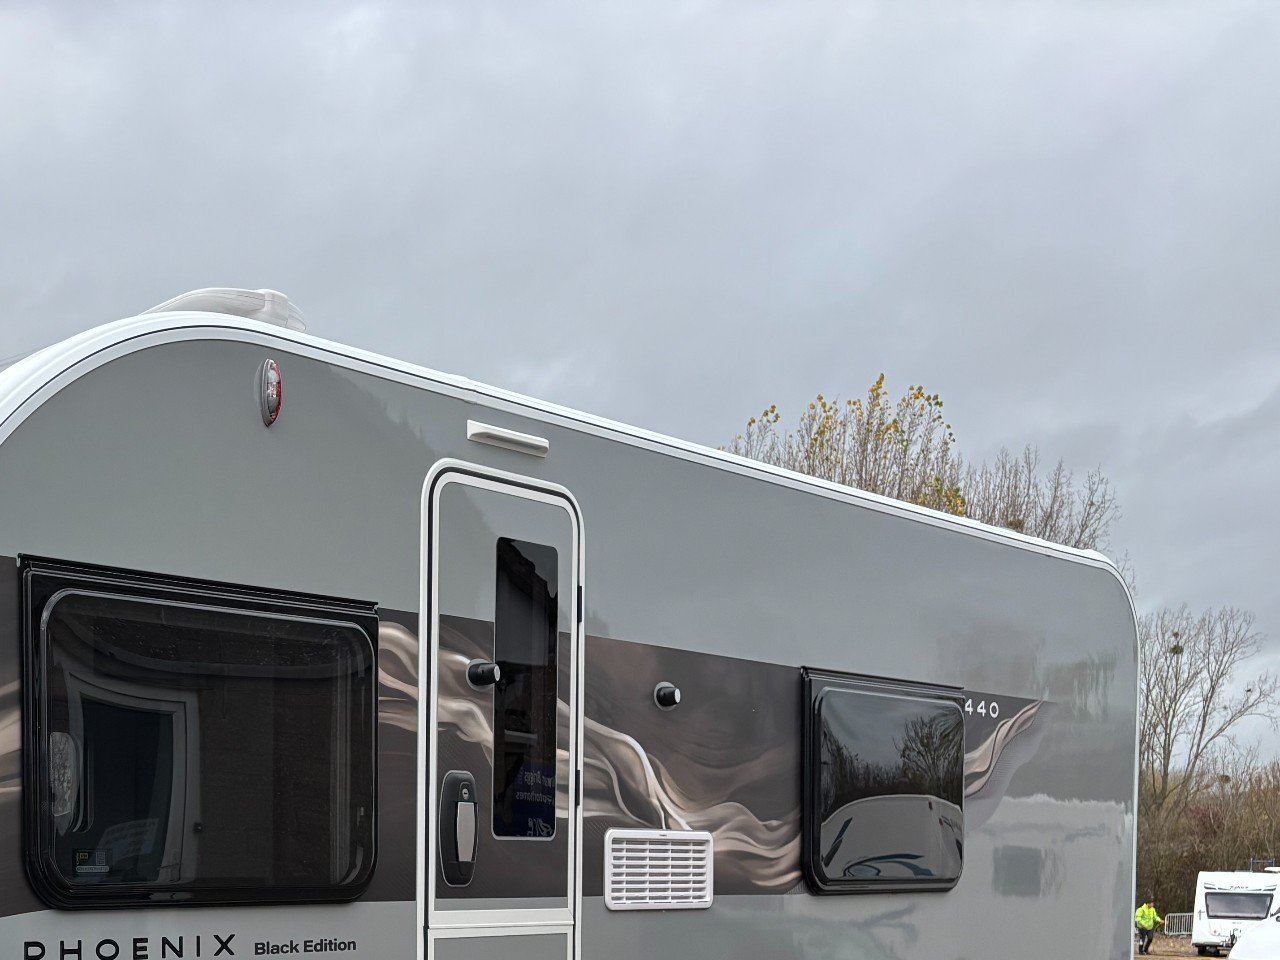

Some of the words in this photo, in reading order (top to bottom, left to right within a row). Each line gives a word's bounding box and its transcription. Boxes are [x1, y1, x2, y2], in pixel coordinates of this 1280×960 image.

[964, 698, 1000, 719] 440
[254, 939, 300, 956] Black
[303, 937, 357, 954] Edition
